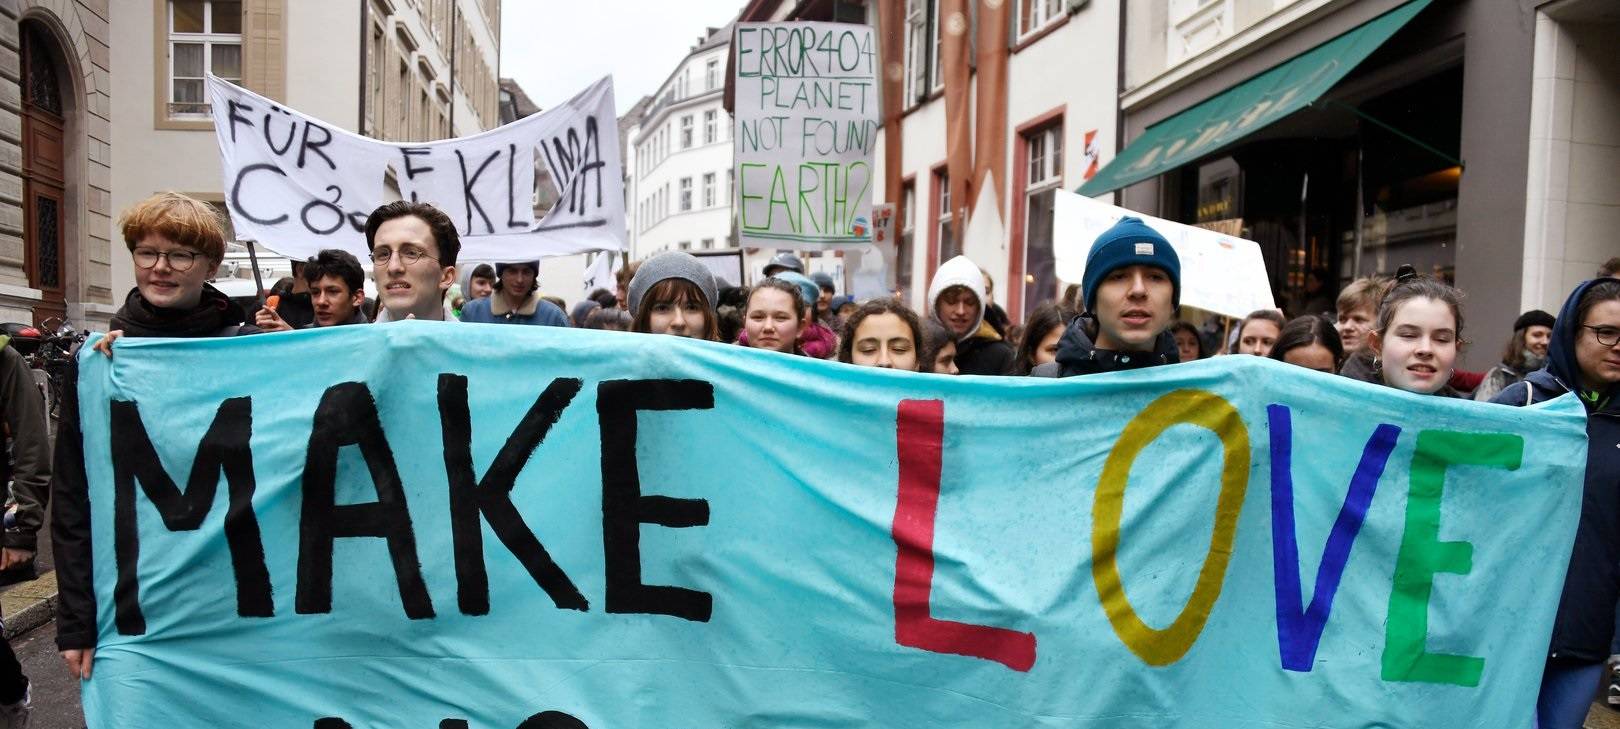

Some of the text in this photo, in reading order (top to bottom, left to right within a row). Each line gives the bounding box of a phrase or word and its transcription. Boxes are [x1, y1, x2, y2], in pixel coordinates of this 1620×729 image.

[761, 77, 872, 114] PLANET
[228, 99, 336, 170] FÜR
[742, 116, 877, 157] NOT FOUND
[454, 115, 606, 236] KLIMA
[109, 373, 1524, 687] MAKE LOVE
